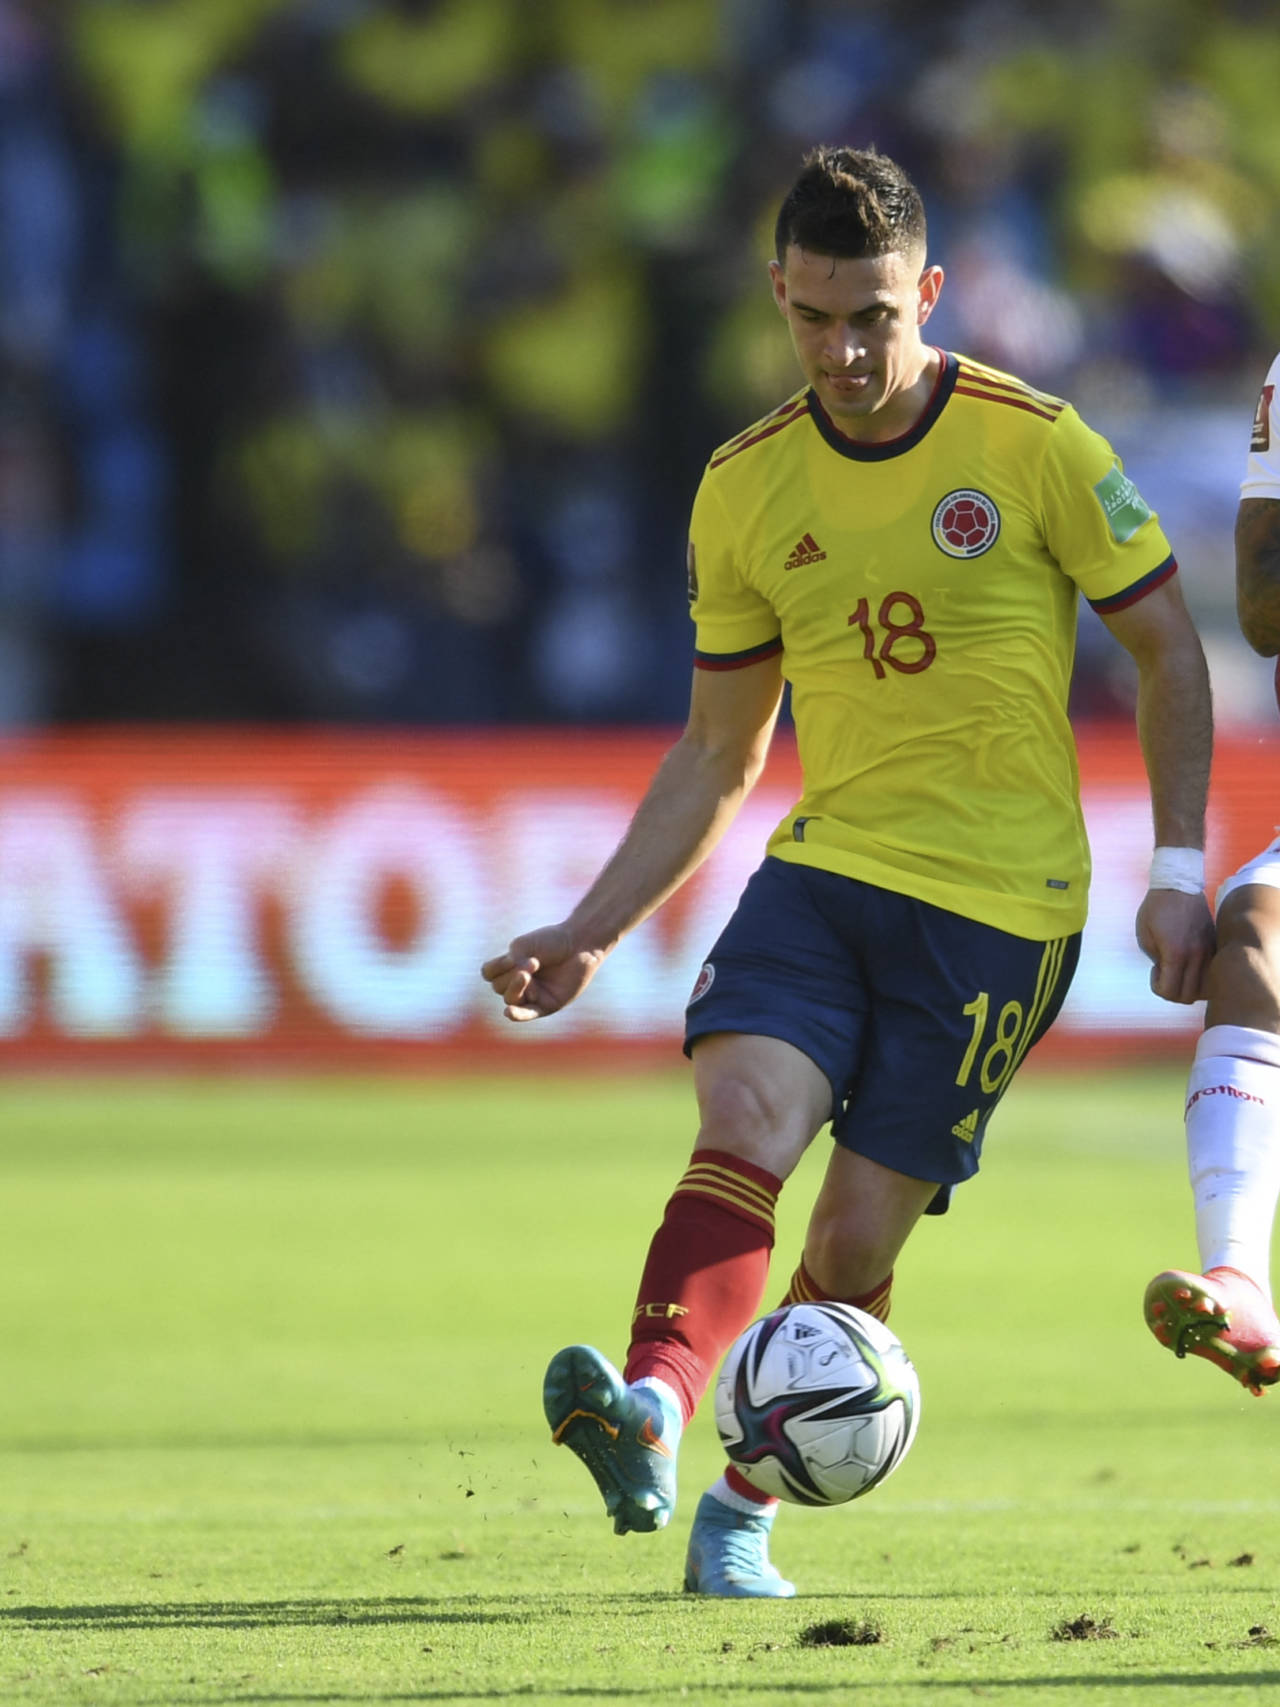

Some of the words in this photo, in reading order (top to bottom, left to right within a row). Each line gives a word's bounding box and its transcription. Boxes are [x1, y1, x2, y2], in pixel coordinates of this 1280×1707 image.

[783, 551, 828, 572] adidas
[847, 590, 937, 681] 18
[955, 991, 1023, 1095] 18
